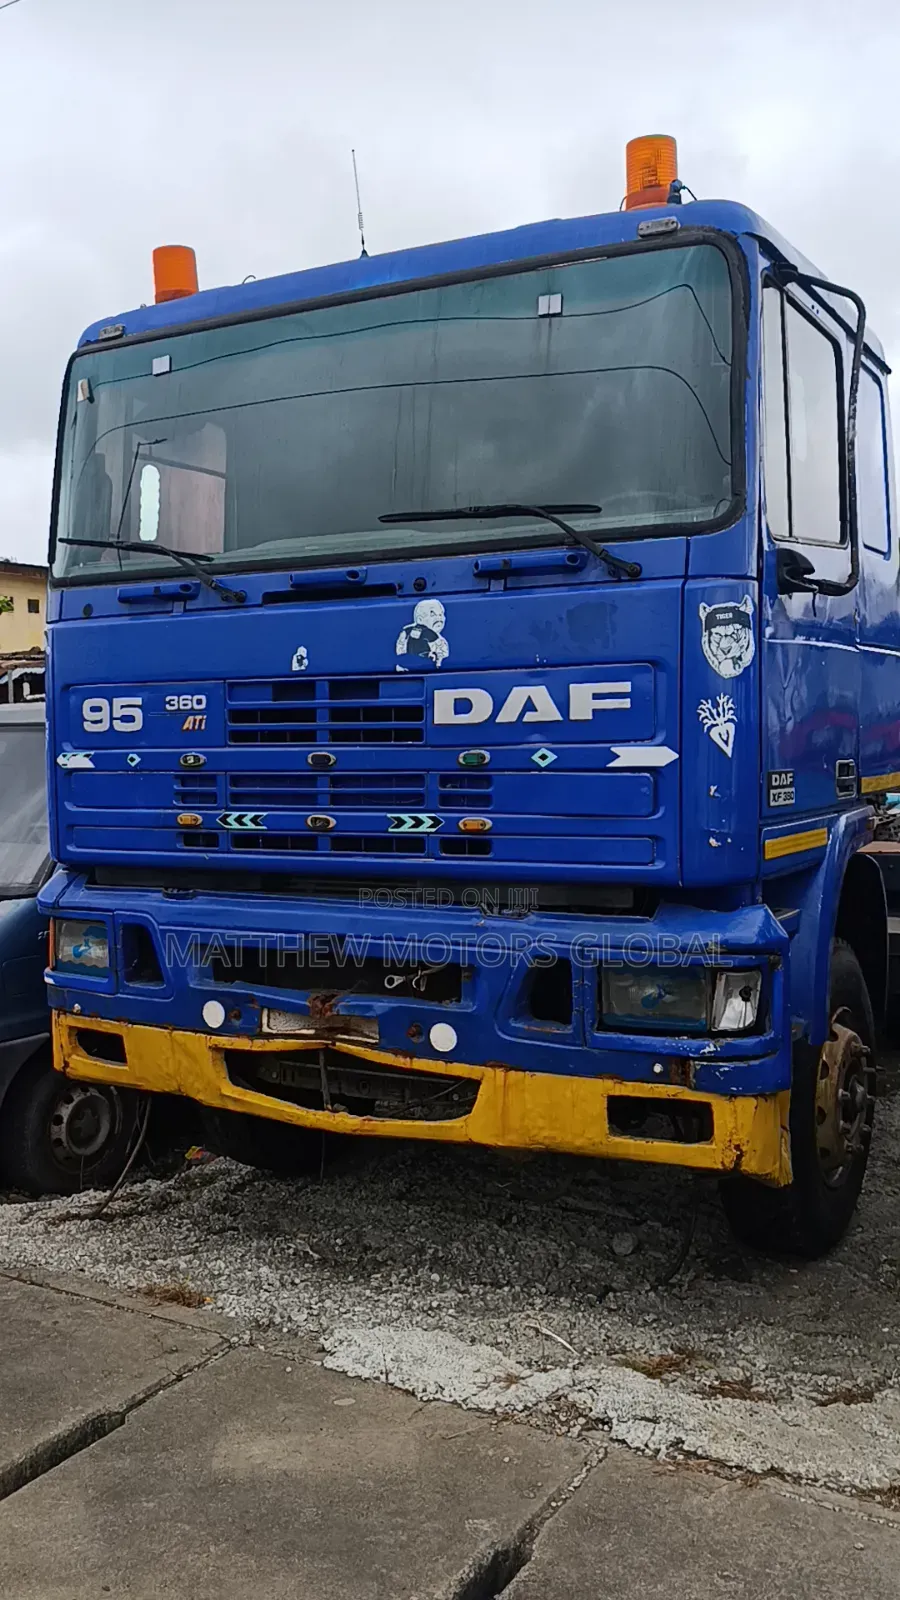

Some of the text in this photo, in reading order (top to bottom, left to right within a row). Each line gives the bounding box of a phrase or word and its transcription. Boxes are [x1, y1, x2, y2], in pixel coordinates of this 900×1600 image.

[165, 695, 207, 710] 360
[433, 681, 632, 724] DAF
[82, 697, 143, 732] 95
[771, 773, 794, 786] DAF
[772, 792, 782, 802] XF
